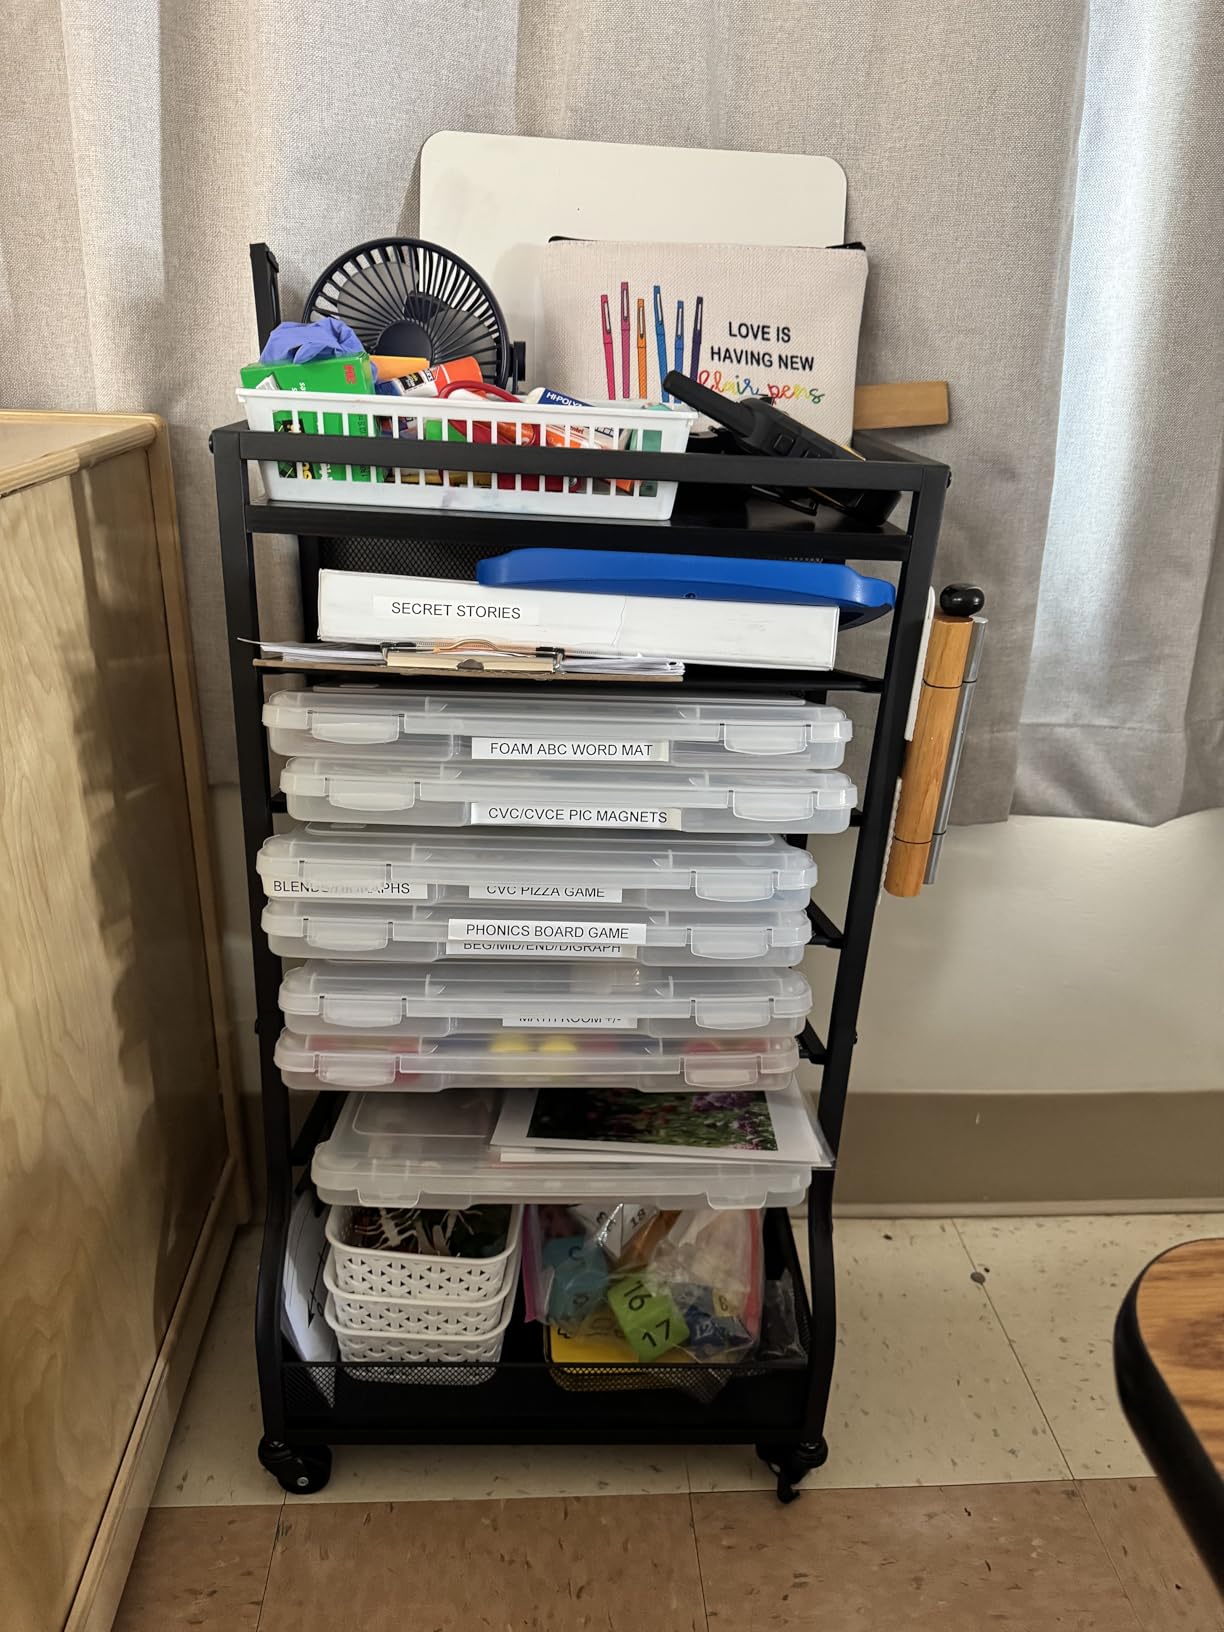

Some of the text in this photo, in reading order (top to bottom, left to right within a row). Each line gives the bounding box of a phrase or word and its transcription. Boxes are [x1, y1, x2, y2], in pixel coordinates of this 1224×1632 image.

[728, 321, 792, 344] LOVE IS
[710, 345, 814, 372] HAVING NEW
[767, 383, 826, 406] pens
[391, 601, 521, 620] SECRET STORIES
[490, 742, 653, 756] FOAM ABC WORD MAT
[488, 807, 668, 823] CVC/CVCE PIC MAGNETS
[486, 885, 606, 898] CVC PIZZA GAME
[466, 923, 629, 940] PHONICS BOARD GAME
[623, 1280, 653, 1312] 16
[641, 1319, 672, 1348] 17
